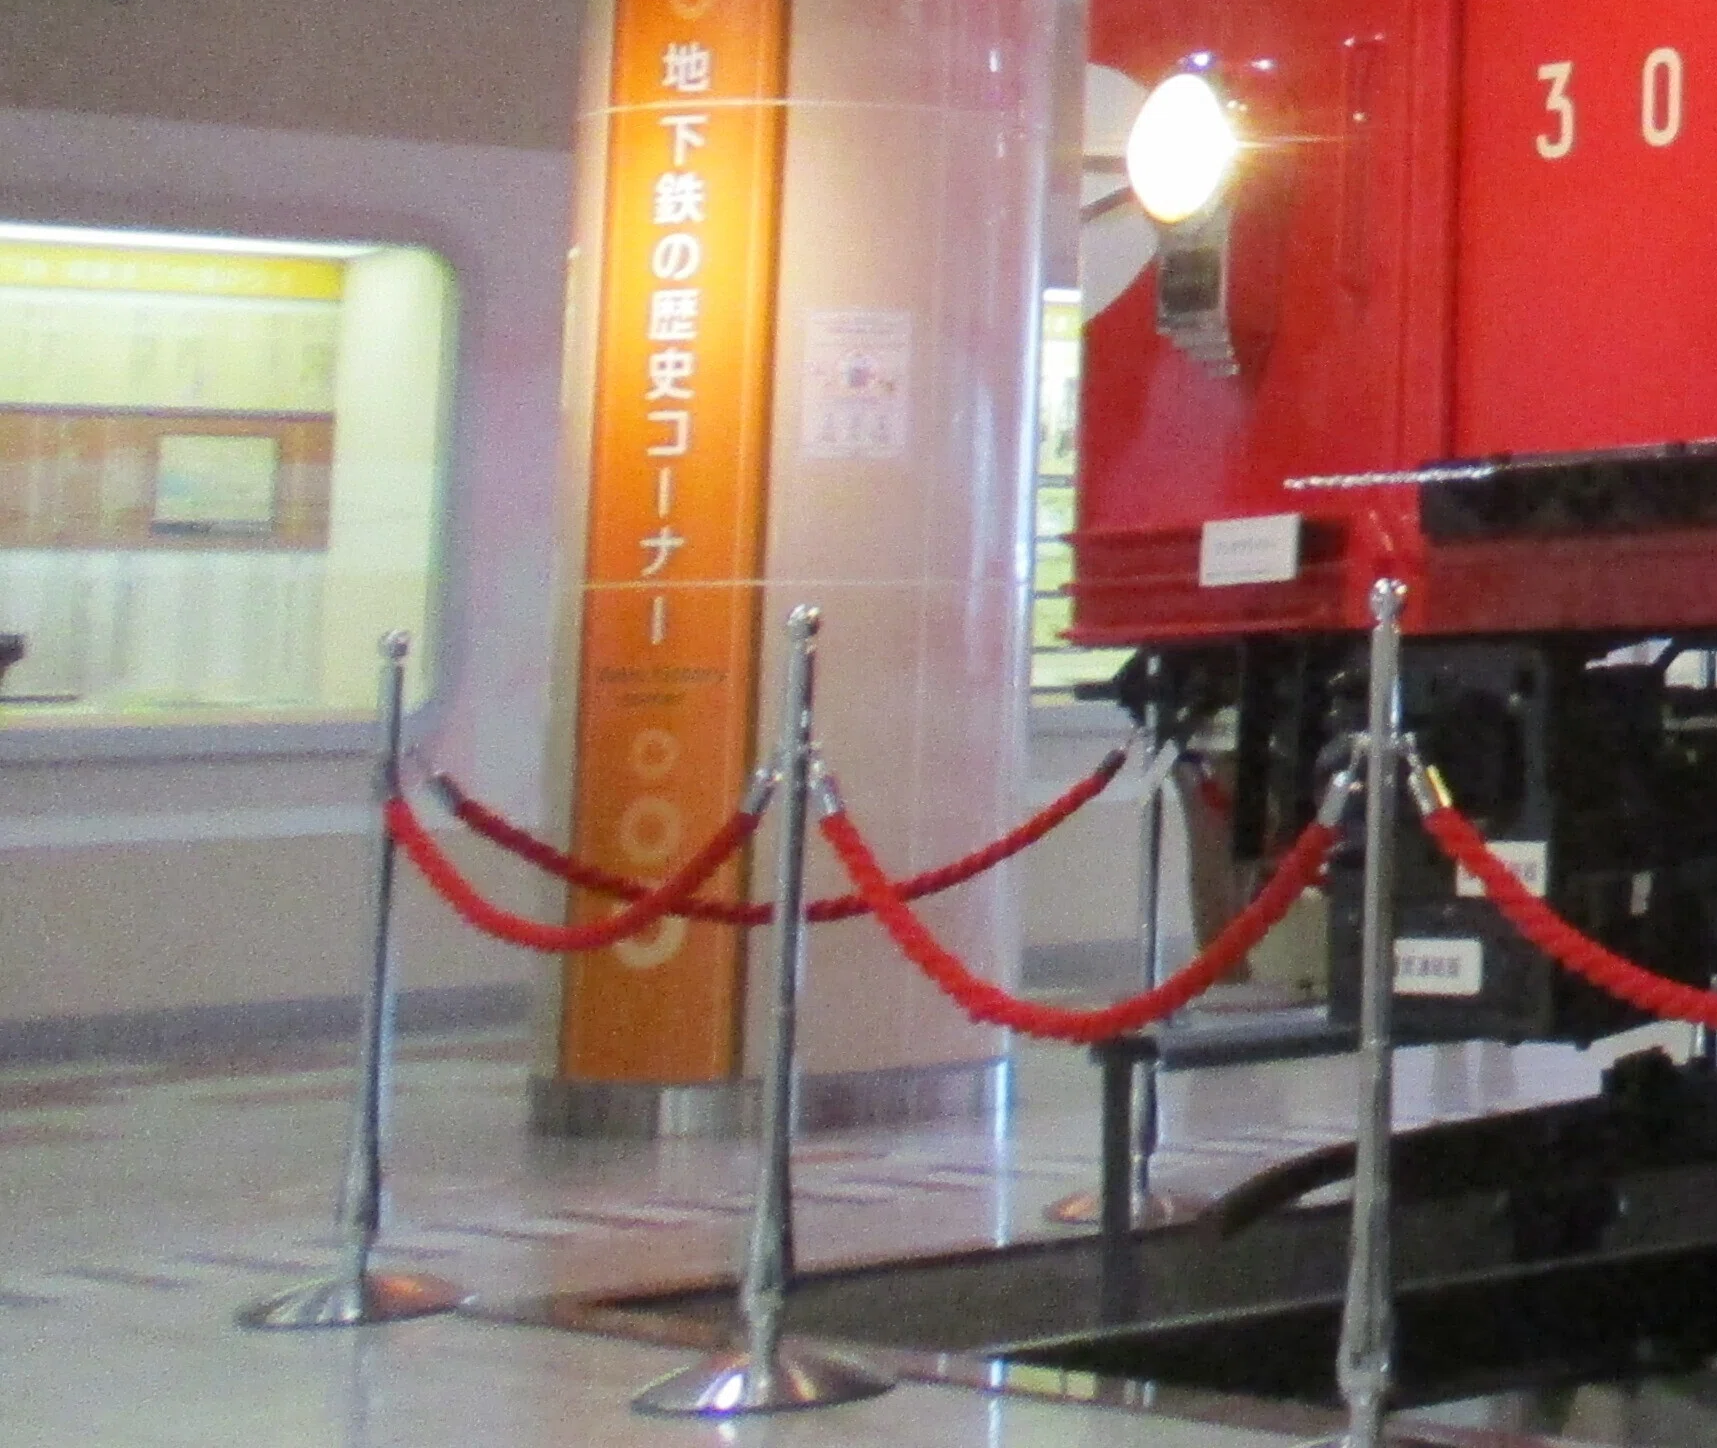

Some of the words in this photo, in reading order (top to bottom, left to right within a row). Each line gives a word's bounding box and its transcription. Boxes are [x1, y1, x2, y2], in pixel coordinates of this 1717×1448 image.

[640, 41, 712, 645] 地下鉄の歴史コーナー
